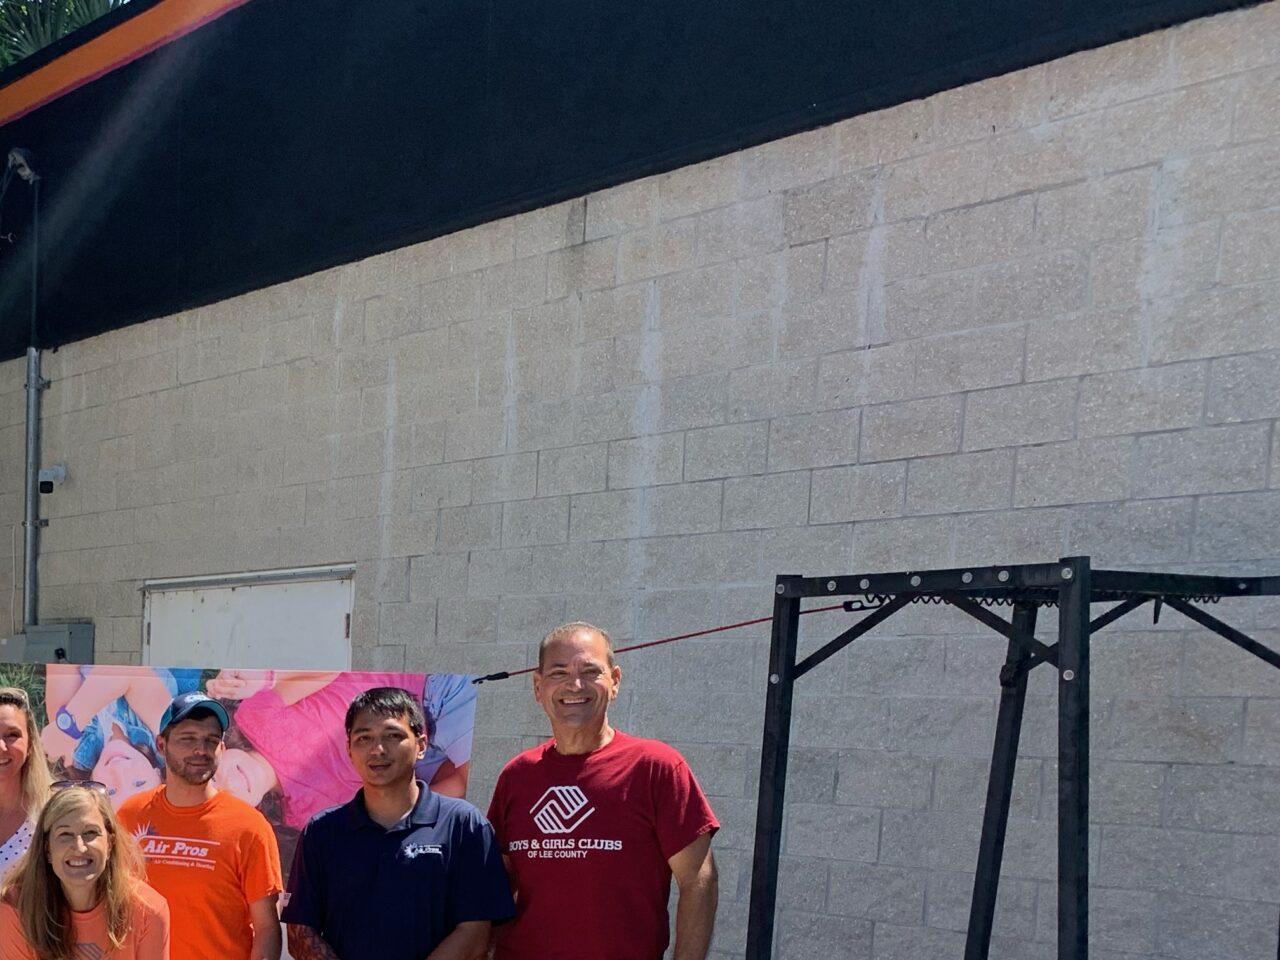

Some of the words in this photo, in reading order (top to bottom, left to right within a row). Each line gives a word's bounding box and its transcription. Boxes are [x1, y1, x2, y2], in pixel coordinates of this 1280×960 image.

[144, 839, 170, 854] Air
[171, 842, 209, 857] Pros
[509, 839, 529, 851] BOYS
[531, 839, 540, 849] &
[542, 839, 575, 849] GIRLS
[578, 839, 623, 850] CLUBS
[527, 851, 538, 859] OF
[554, 850, 588, 859] COUNTY
